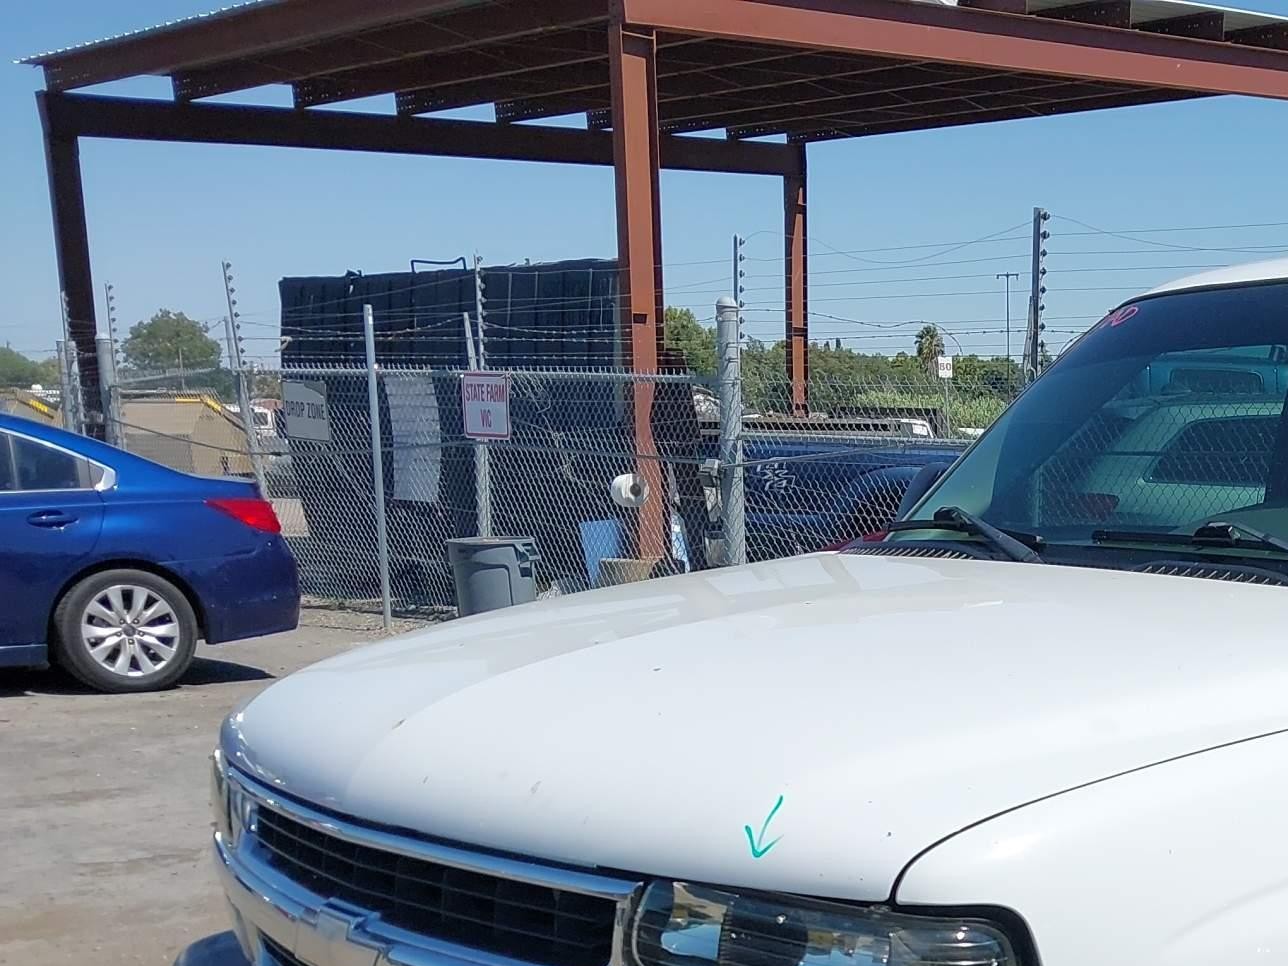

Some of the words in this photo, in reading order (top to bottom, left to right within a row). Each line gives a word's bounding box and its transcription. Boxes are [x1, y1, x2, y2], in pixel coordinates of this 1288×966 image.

[466, 384, 485, 401] STATE
[486, 384, 505, 402] FARM
[286, 400, 305, 418] DROP
[306, 402, 326, 420] ZONE
